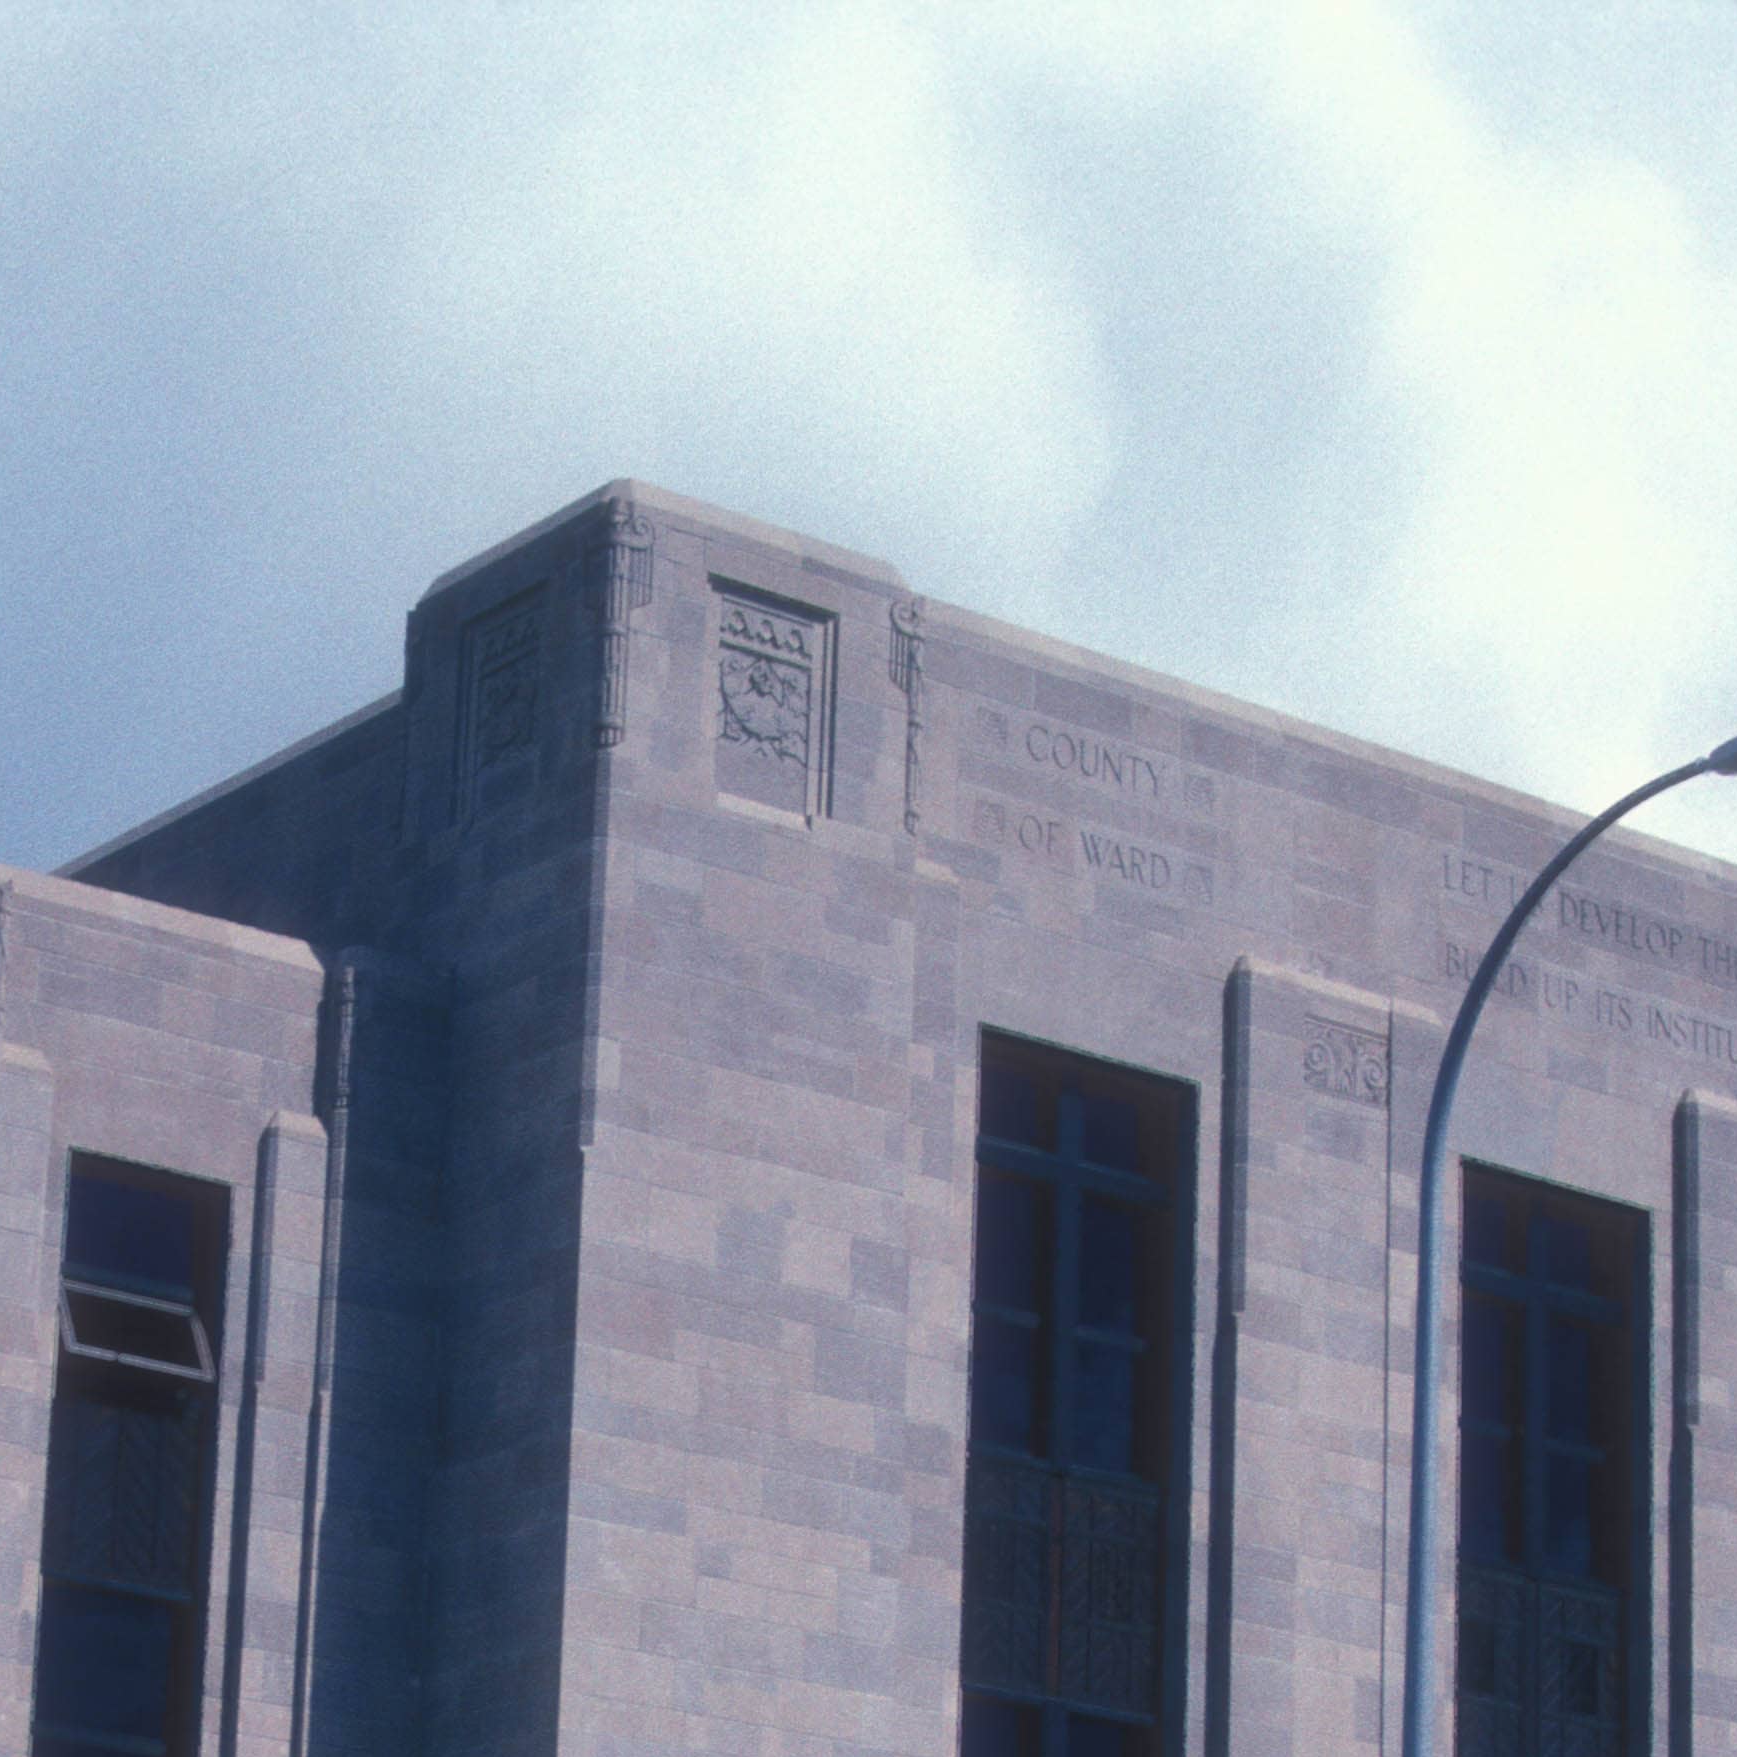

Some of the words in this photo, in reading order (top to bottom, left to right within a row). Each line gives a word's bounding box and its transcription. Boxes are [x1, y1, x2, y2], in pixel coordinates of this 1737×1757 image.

[1025, 723, 1159, 798] COUNTY
[1018, 814, 1062, 855] OF
[1079, 831, 1171, 889] WARD
[1444, 854, 1494, 900] LET
[1560, 890, 1683, 958] DEVELOP
[1543, 973, 1579, 1012] UP
[1596, 991, 1634, 1030] ITS
